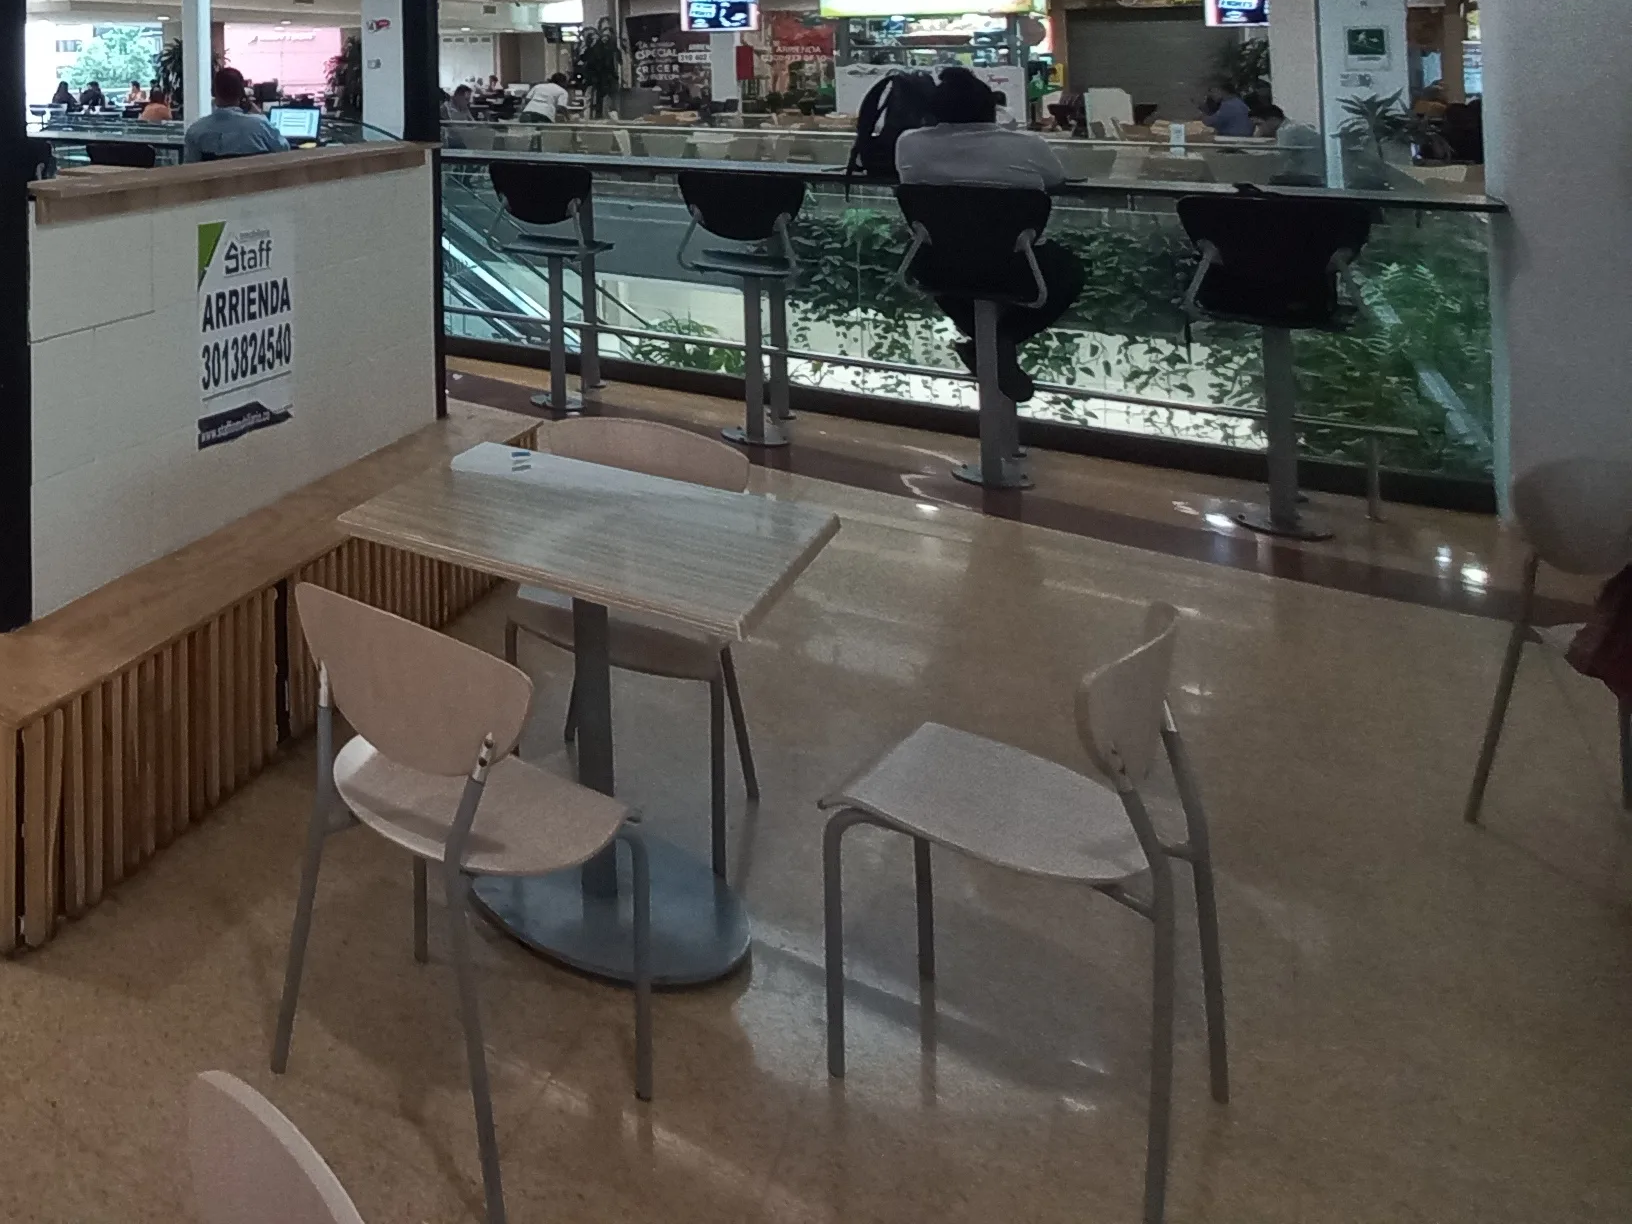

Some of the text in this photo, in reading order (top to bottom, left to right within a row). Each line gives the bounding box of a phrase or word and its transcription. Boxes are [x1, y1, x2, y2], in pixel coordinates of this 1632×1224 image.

[224, 240, 272, 274] Staff
[202, 277, 291, 333] ARRIENDA
[202, 323, 291, 390] 3013824540
